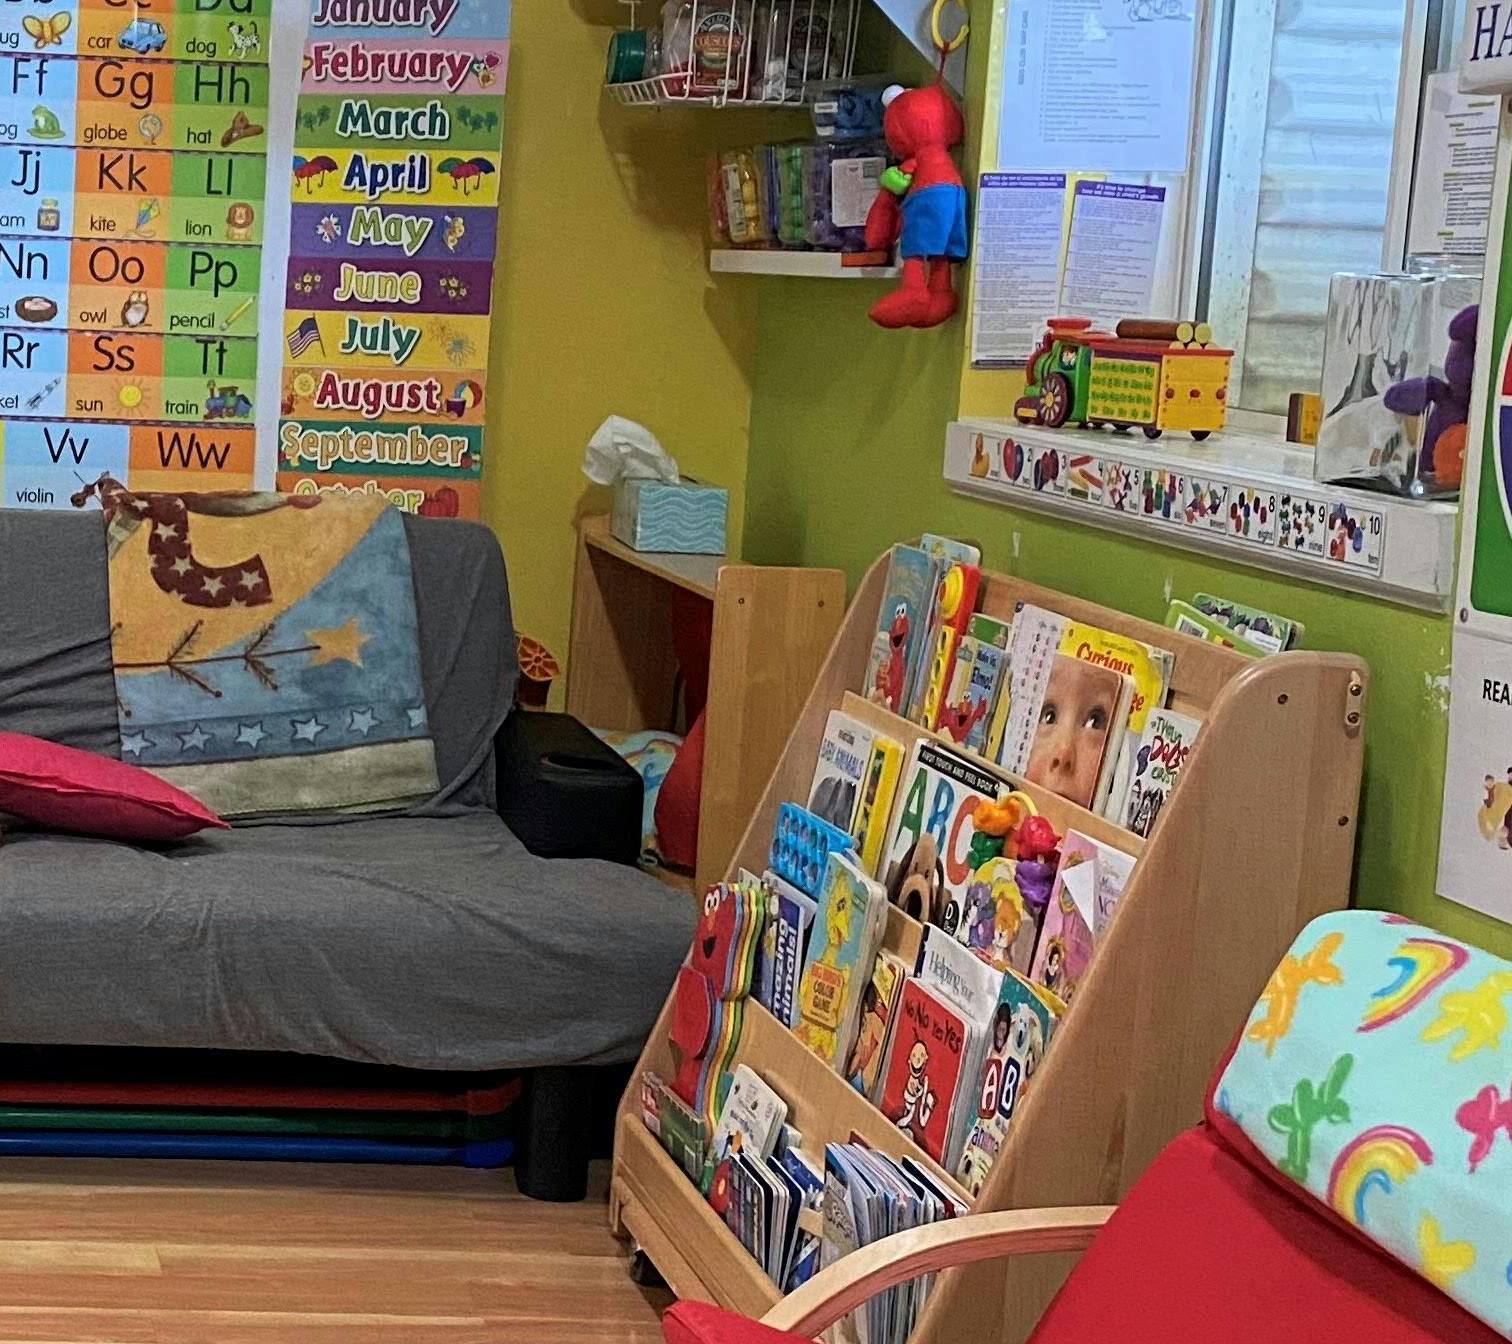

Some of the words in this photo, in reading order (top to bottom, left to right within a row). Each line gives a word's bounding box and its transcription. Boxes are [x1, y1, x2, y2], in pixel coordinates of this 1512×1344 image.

[88, 36, 113, 49] car
[186, 37, 216, 58] dog
[13, 58, 48, 96] Ff
[314, 44, 473, 88] February
[94, 61, 153, 110] Gg
[195, 65, 250, 104] Hh
[84, 124, 128, 143] globe
[187, 128, 212, 144] hat
[338, 102, 447, 137] March
[11, 150, 41, 195] Jj
[98, 153, 147, 192] Kk
[207, 158, 233, 196] Ll
[343, 154, 427, 196] April
[90, 216, 116, 232] kite
[185, 219, 212, 236] lion
[349, 208, 431, 253] May
[89, 246, 144, 284] Oo
[190, 251, 237, 298] Pp
[336, 266, 419, 301] June
[79, 308, 107, 324] owl
[170, 313, 215, 330] pencil
[2, 333, 40, 369] Rr
[93, 335, 135, 372] Ss
[195, 339, 228, 375] Tt
[342, 318, 418, 361] July
[76, 399, 103, 412] sun
[165, 400, 199, 415] train
[316, 374, 438, 415] August
[43, 427, 89, 464] Vv
[157, 431, 231, 469] Ww
[282, 425, 466, 467] September
[1062, 455, 1067, 469] 3
[1098, 458, 1103, 472] 4
[1134, 470, 1139, 485] 5
[16, 488, 54, 503] violin
[1179, 478, 1183, 493] 6
[1222, 486, 1228, 503] 7
[1269, 495, 1275, 512] 8
[1318, 506, 1325, 523] 9
[1369, 516, 1380, 535] 10
[929, 951, 960, 994] Helping
[915, 1002, 929, 1028] No
[944, 1019, 961, 1054] Yes
